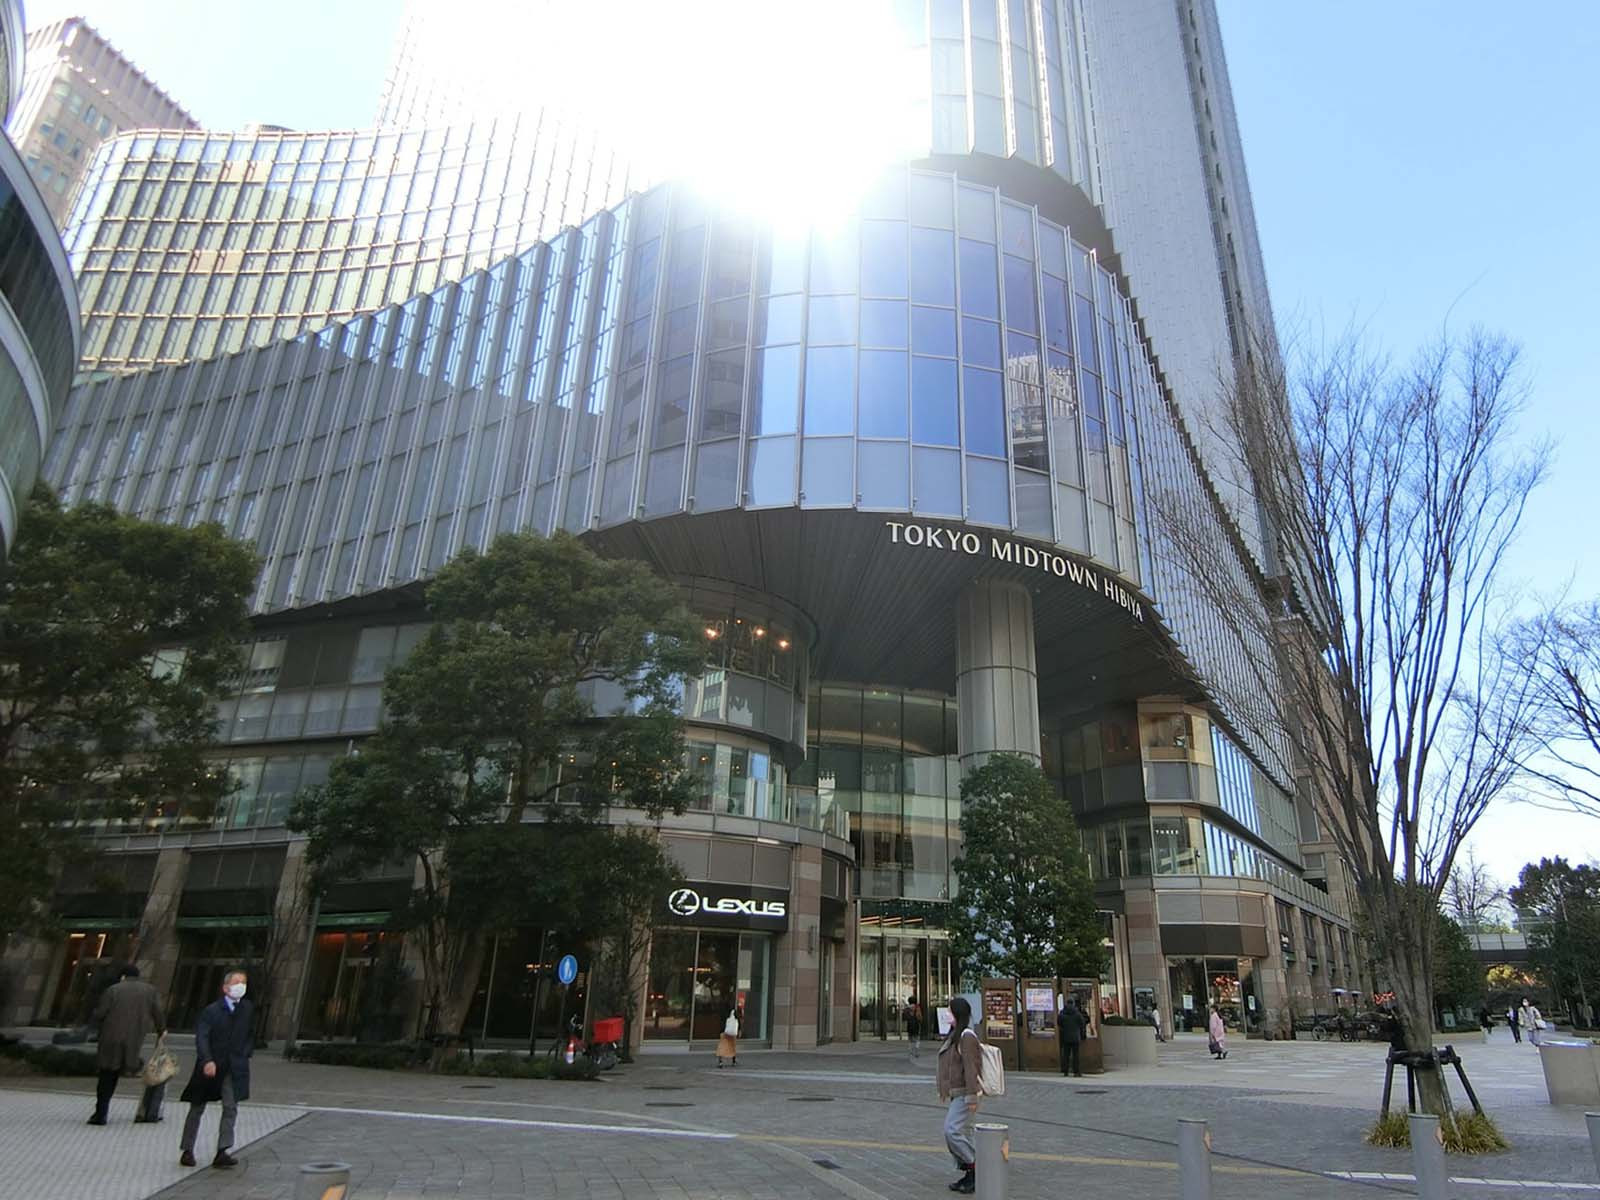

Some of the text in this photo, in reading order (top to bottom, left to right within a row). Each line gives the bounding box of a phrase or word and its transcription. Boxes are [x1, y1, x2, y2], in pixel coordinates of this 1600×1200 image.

[886, 521, 1144, 622] TOKYO MIDTOWN HIBIYA
[702, 897, 785, 916] LEXUS
